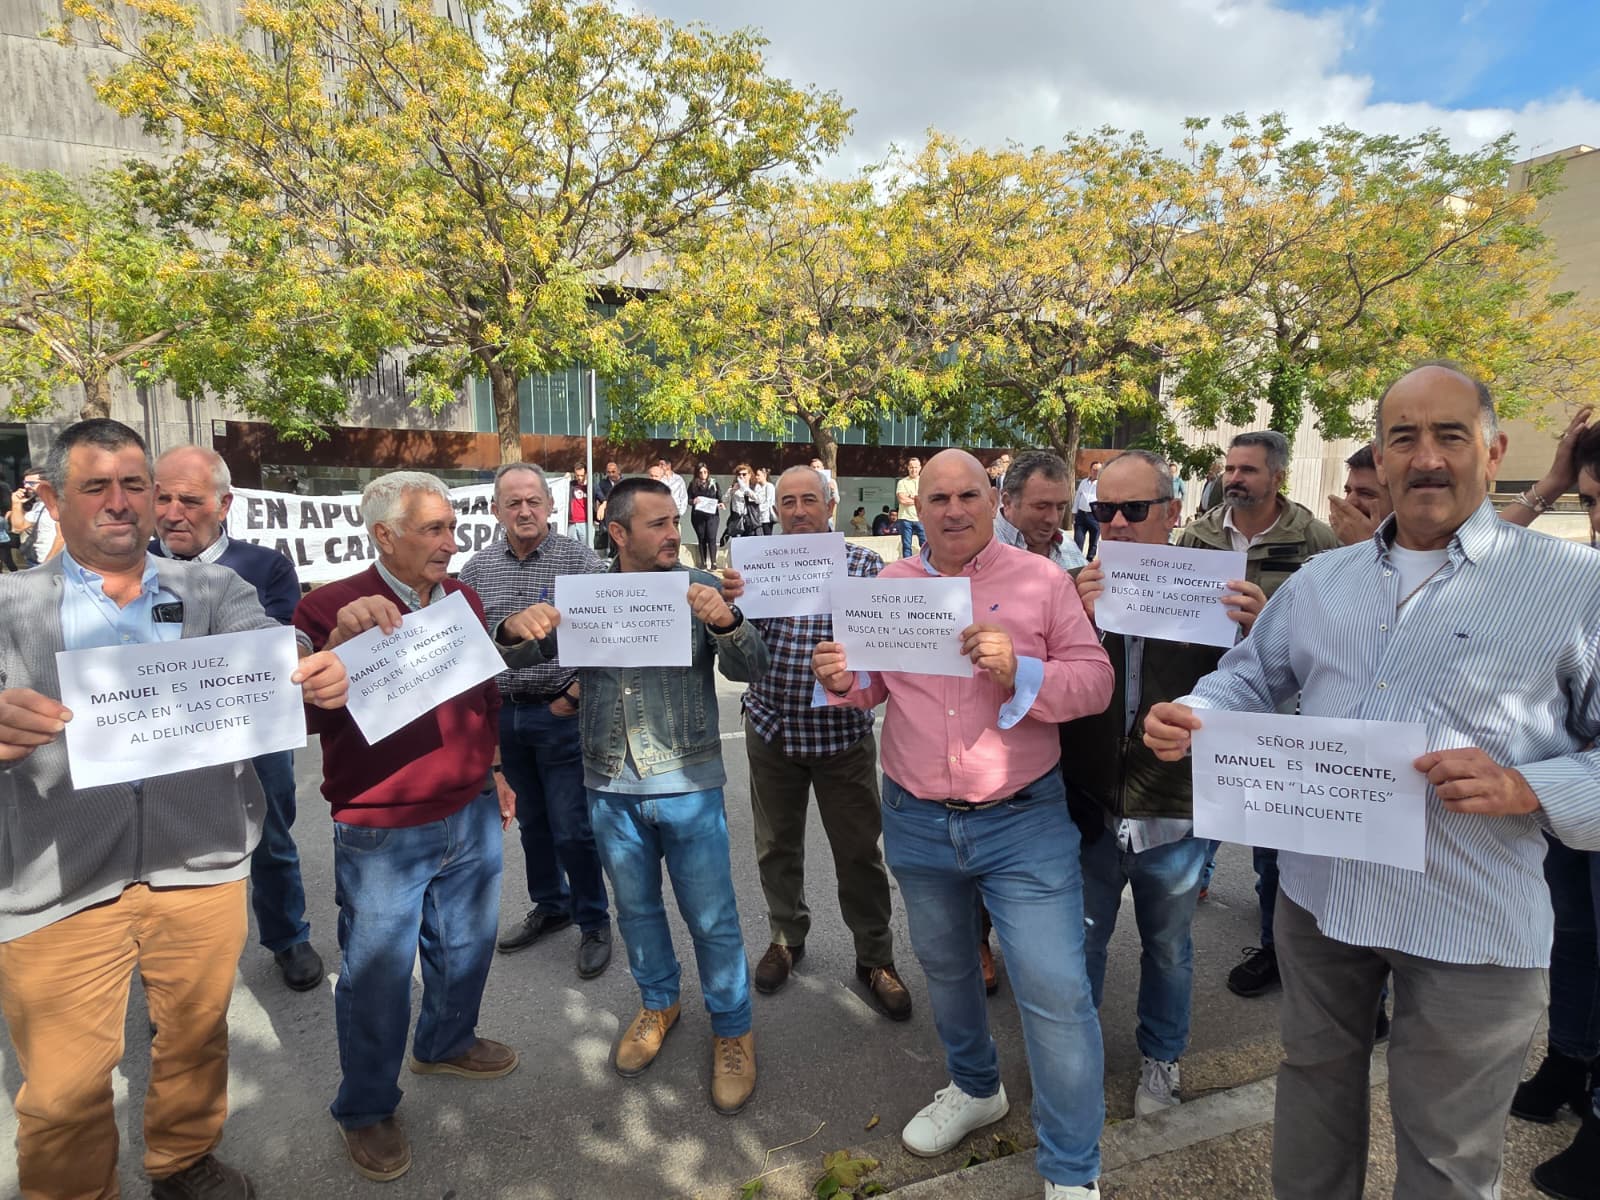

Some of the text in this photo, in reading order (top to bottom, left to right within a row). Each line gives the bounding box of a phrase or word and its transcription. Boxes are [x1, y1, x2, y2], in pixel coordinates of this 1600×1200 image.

[247, 497, 288, 529] EN
[299, 500, 365, 529] APU
[1140, 558, 1195, 571] SEÑOR JUEZ,
[771, 586, 819, 596] DELINCUENTE
[1111, 572, 1150, 581] MANUEL
[1174, 577, 1224, 591] INOCENTE,
[596, 589, 623, 598] SEÑOR
[872, 594, 926, 604] SEÑOR JUEZ,
[1111, 587, 1139, 596] BUSCA
[1142, 589, 1153, 597] EN
[1163, 592, 1178, 600] LAS
[569, 606, 607, 614] MANUEL
[630, 604, 675, 613] INOCENTE,
[845, 610, 883, 618] MANUEL
[908, 612, 955, 620] INOCENTE,
[1127, 603, 1200, 618] AL DELINCUENTE
[848, 625, 875, 634] BUSCA
[371, 626, 428, 654] SEÑOR JUEZ,
[602, 635, 659, 644] DELINCUENTE
[350, 624, 463, 683] MANUEL ES INOCENTE,
[137, 657, 229, 675] SEÑOR JUEZ,
[361, 676, 390, 697] BUSCA
[391, 668, 403, 680] EN
[410, 655, 428, 668] LAS
[387, 657, 458, 702] AL DELINCUENTE
[91, 672, 276, 704] MANUEL ES INOCENTE,
[96, 710, 147, 727] BUSCA
[152, 706, 171, 718] EN
[187, 700, 212, 712] LAS
[131, 715, 251, 744] AL DELINCUENTE
[1257, 735, 1347, 755] SEÑOR JUEZ,
[1215, 754, 1396, 782] MANUEL ES INOCENTE,
[1218, 776, 1261, 789] BUSCA
[1266, 780, 1284, 791] EN
[1300, 783, 1324, 796] LAS
[1244, 801, 1362, 823] AL DELINCUENTE
